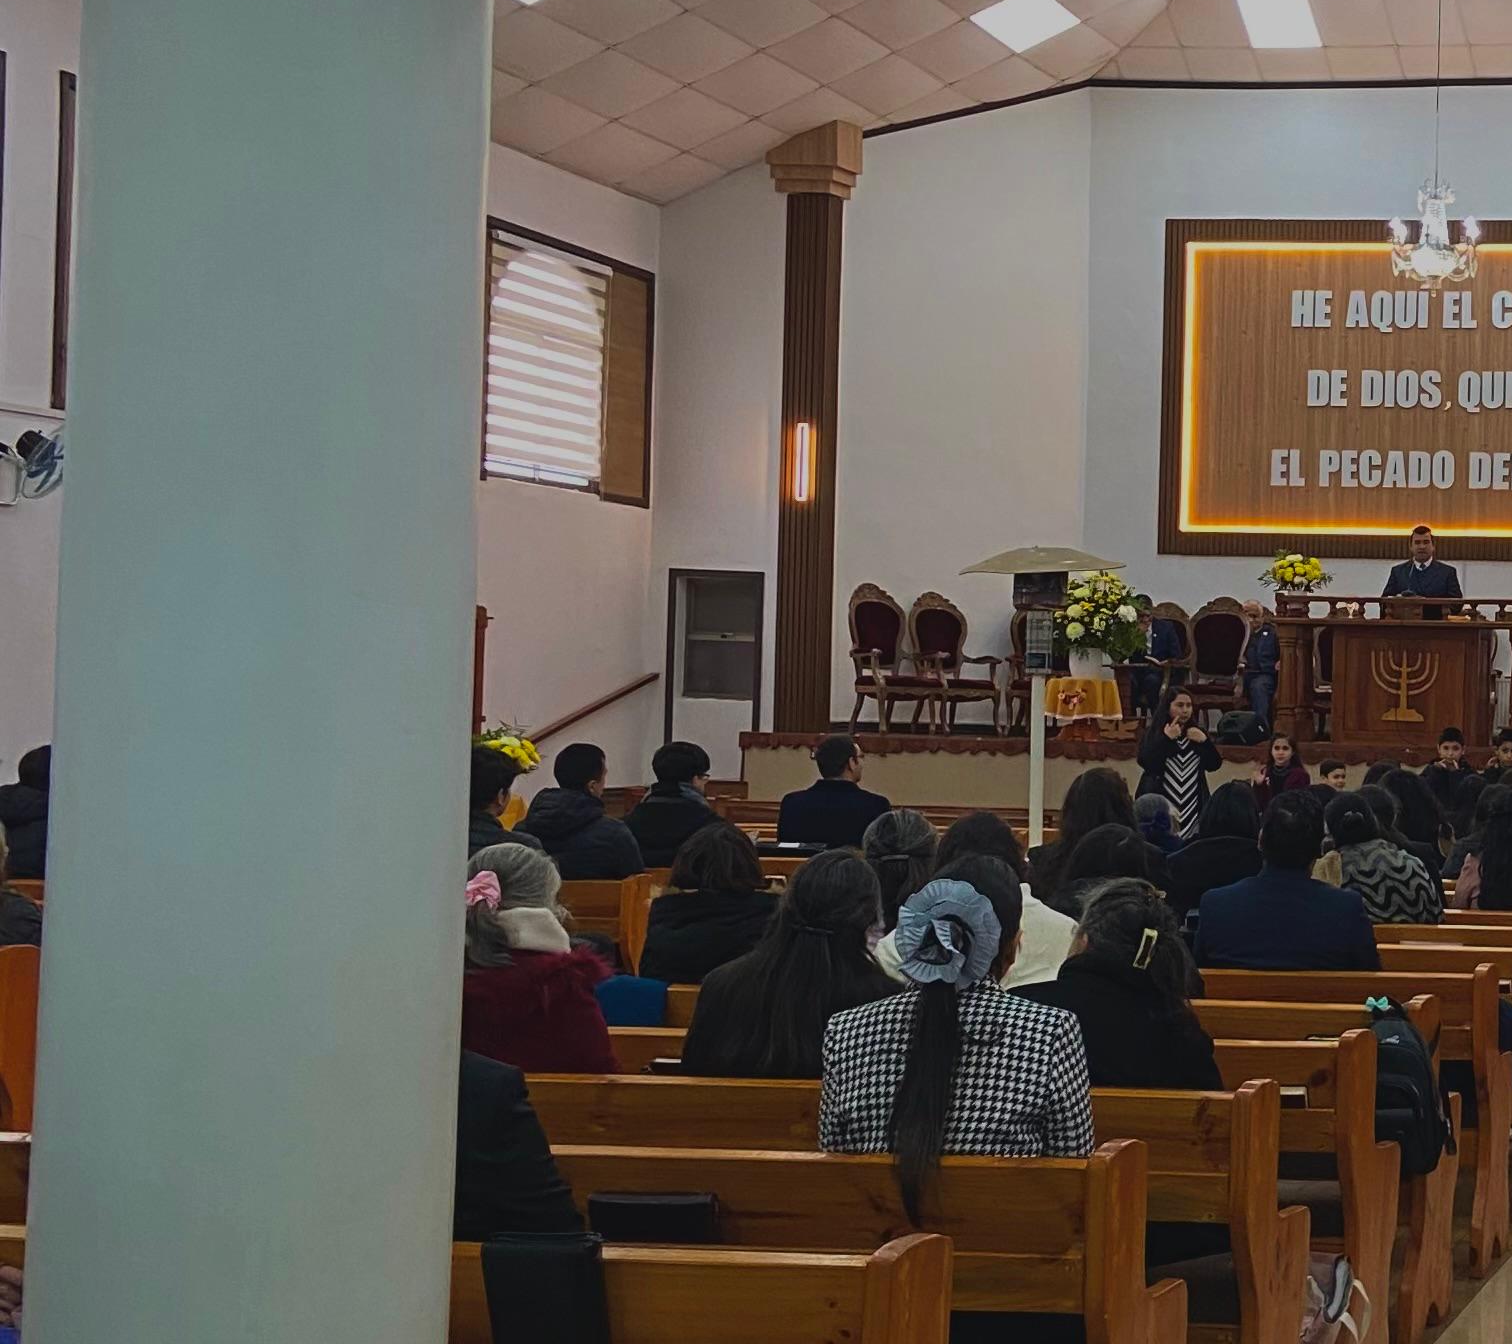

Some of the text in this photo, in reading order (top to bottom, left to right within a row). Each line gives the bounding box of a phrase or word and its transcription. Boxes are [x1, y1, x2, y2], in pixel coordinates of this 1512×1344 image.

[1291, 290, 1332, 328] HE
[1442, 291, 1477, 329] EL
[1307, 369, 1348, 407] DE
[1360, 369, 1452, 411] DIOS,
[1270, 449, 1305, 487] EL
[1318, 449, 1455, 490] PECADO
